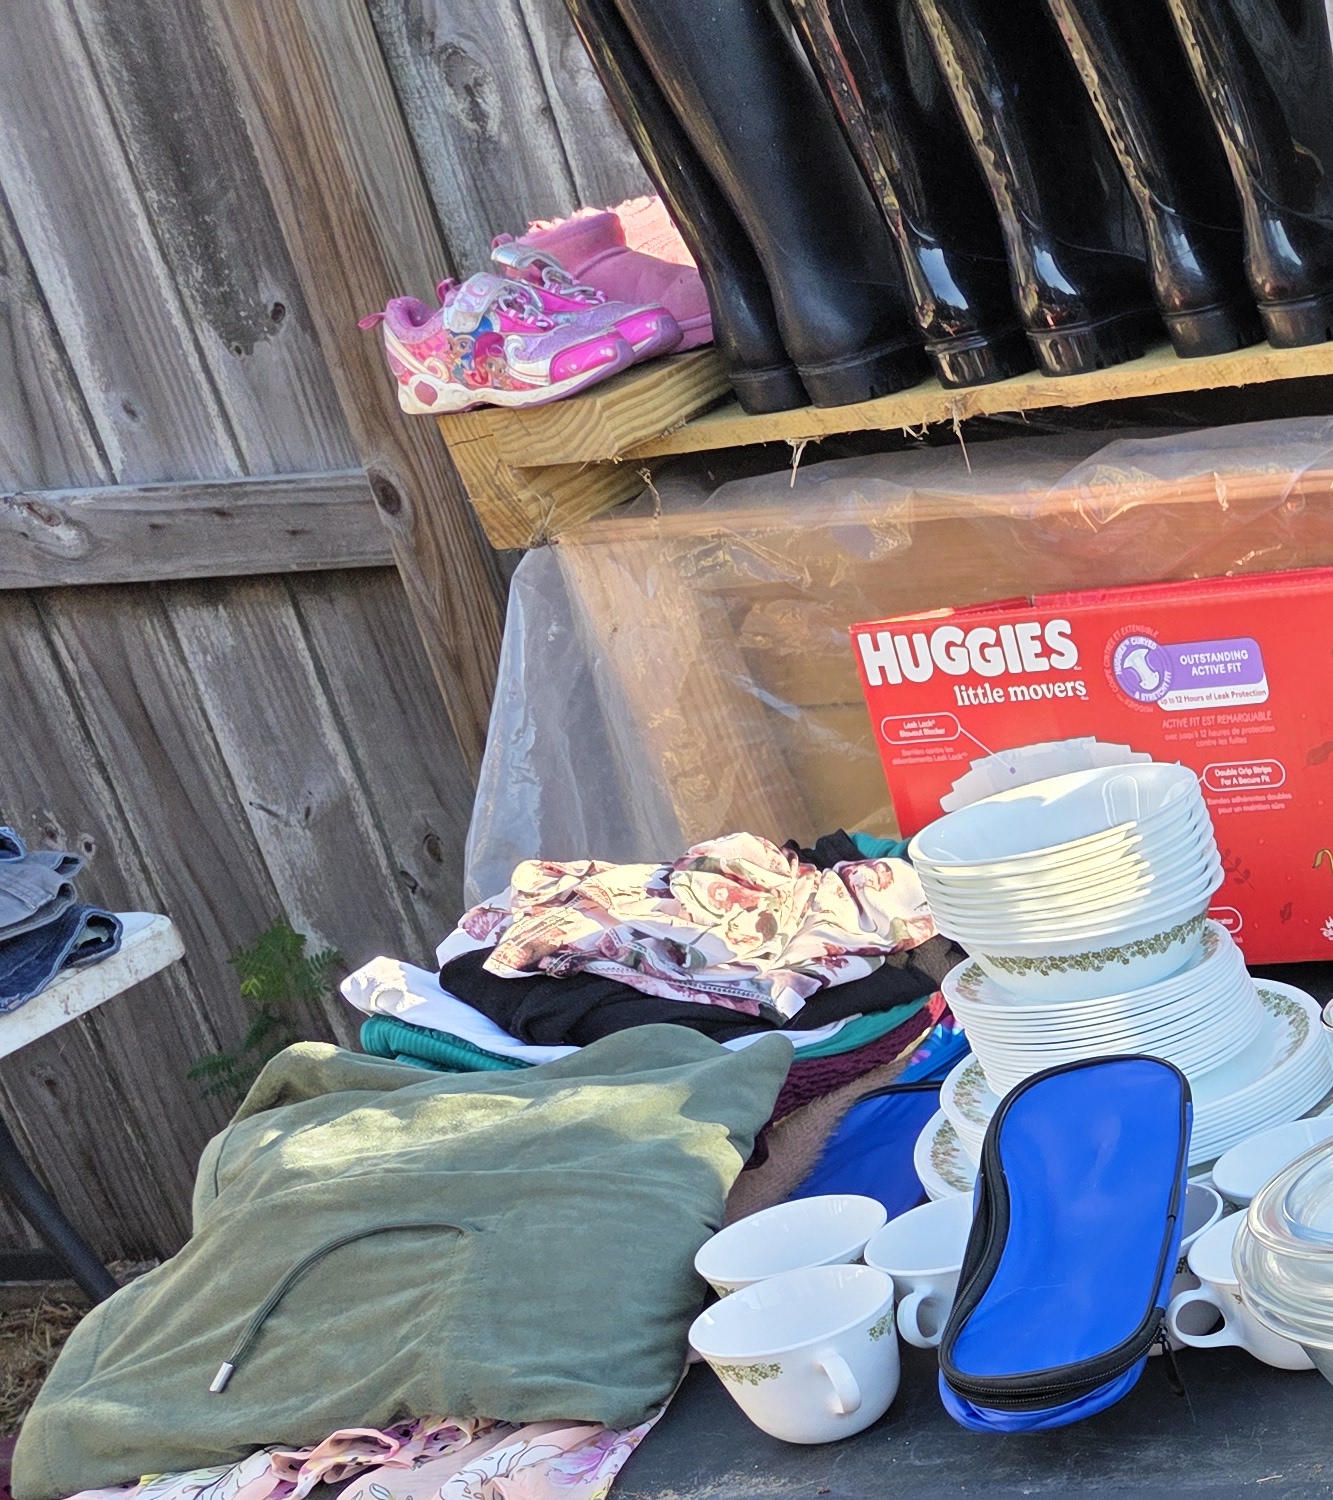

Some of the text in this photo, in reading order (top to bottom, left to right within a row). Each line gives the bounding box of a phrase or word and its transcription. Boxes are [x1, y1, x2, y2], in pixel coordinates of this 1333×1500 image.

[857, 619, 1079, 687] HUGGIES
[1179, 650, 1249, 666] OUTSTANDING
[1191, 662, 1242, 677] ACTIVE FIT
[953, 682, 1006, 706] little
[1007, 680, 1087, 702] movers
[1184, 693, 1205, 703] Hours
[1205, 692, 1213, 701] of
[1213, 691, 1230, 700] Leak
[1231, 689, 1267, 699] Protection
[1162, 716, 1188, 729] ACTIVE
